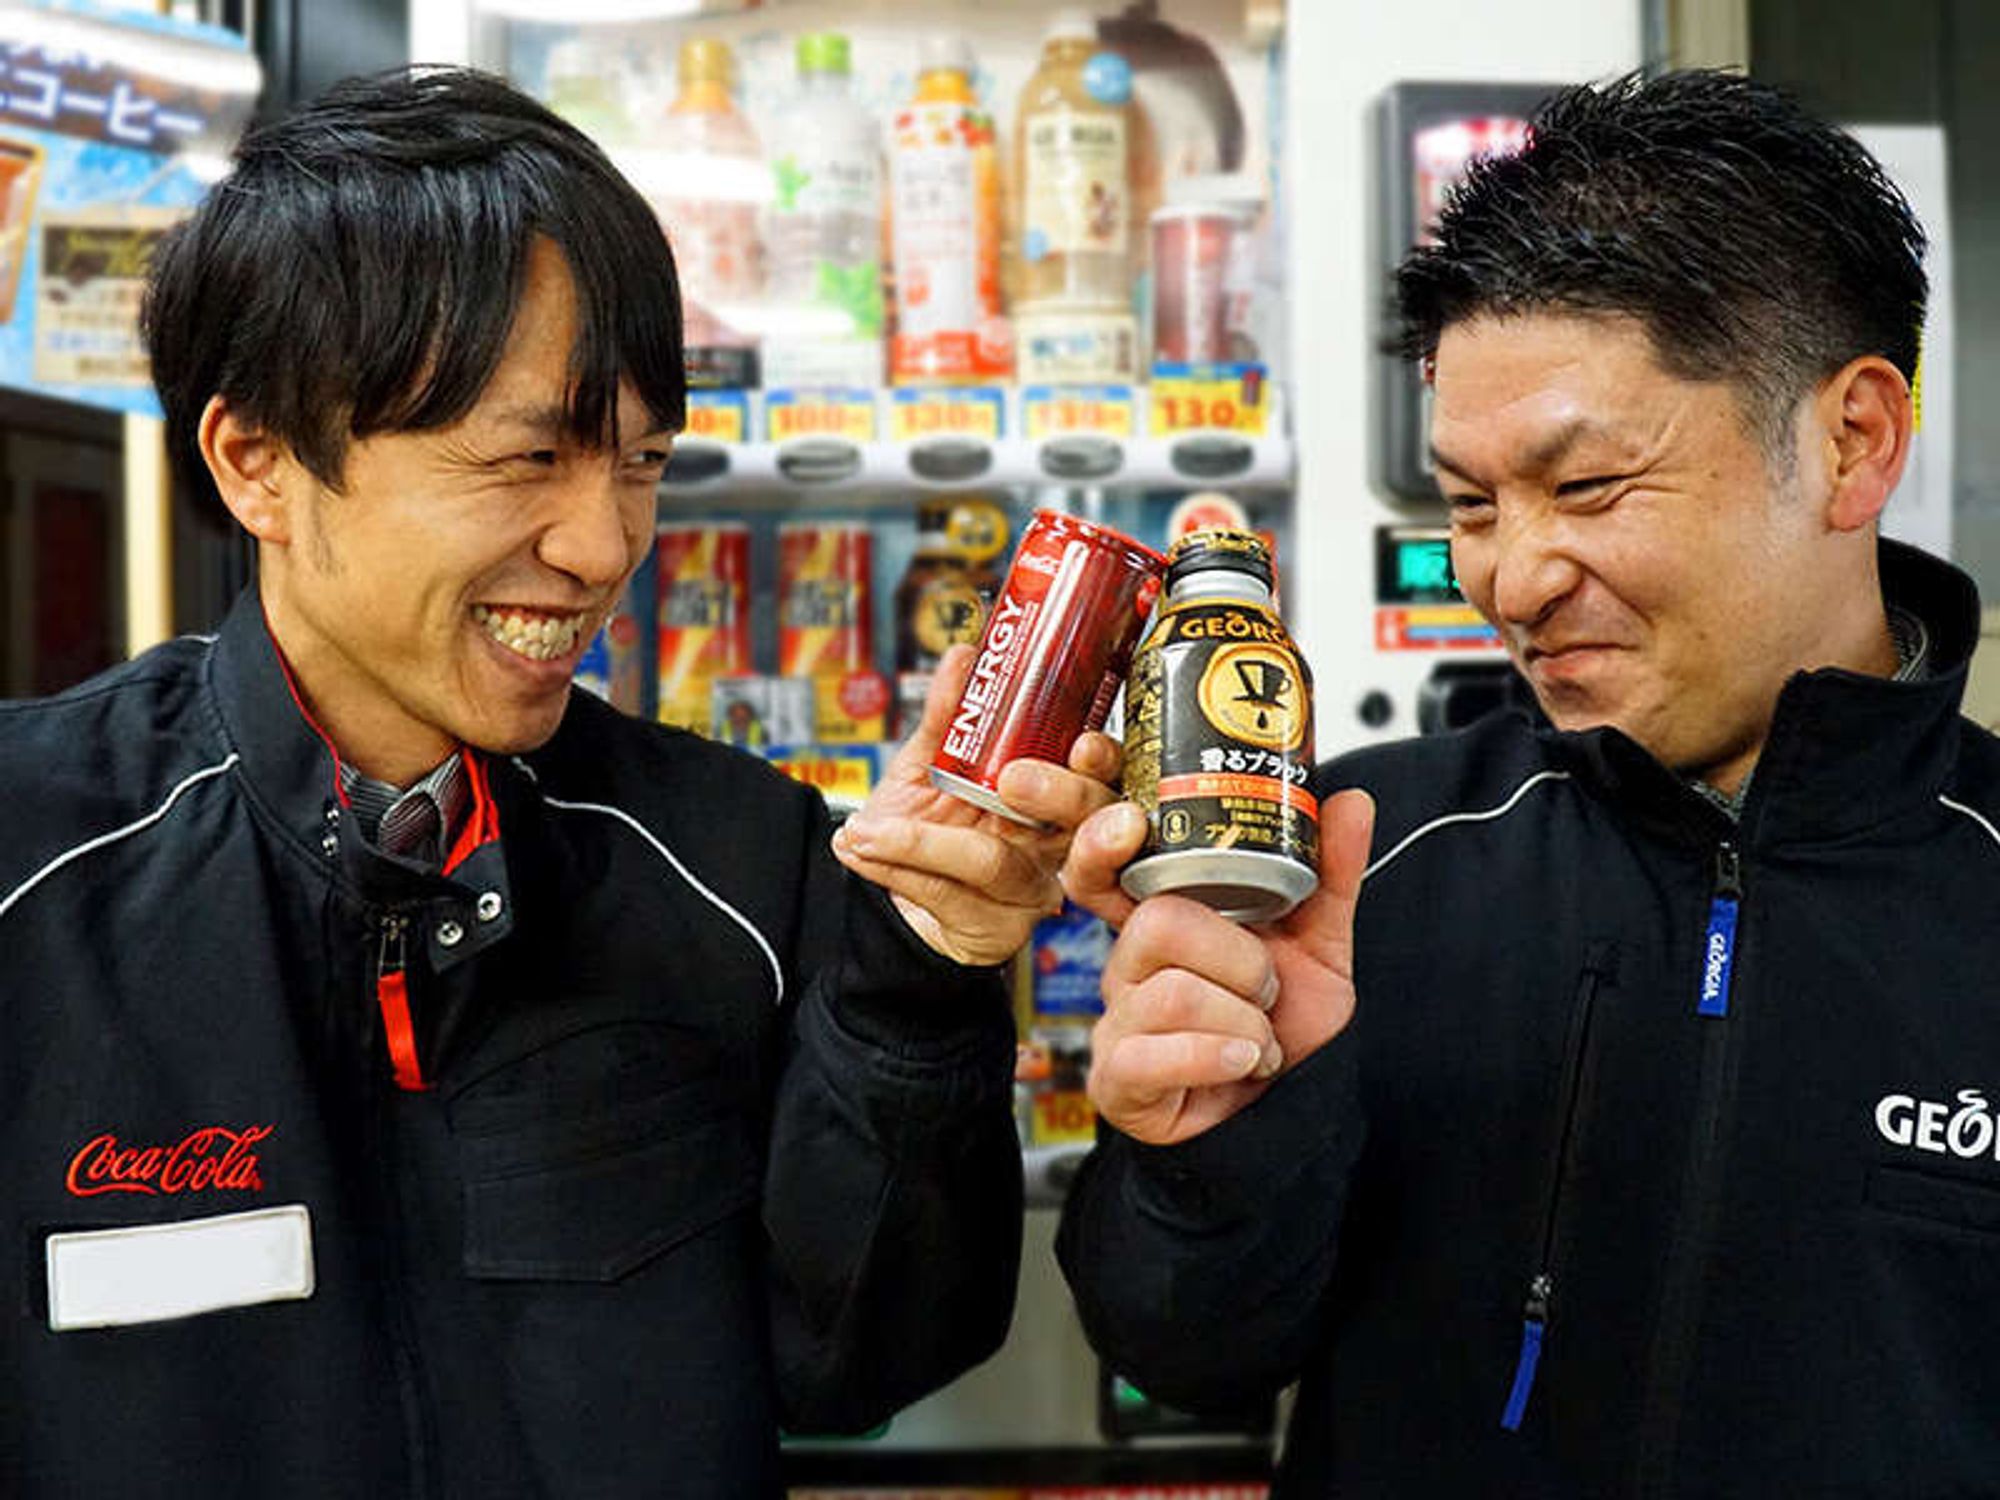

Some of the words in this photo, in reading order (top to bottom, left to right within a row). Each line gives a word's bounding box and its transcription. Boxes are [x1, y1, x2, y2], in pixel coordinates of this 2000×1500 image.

[0, 62, 205, 142] コーヒー
[942, 595, 1022, 762] ENERGY
